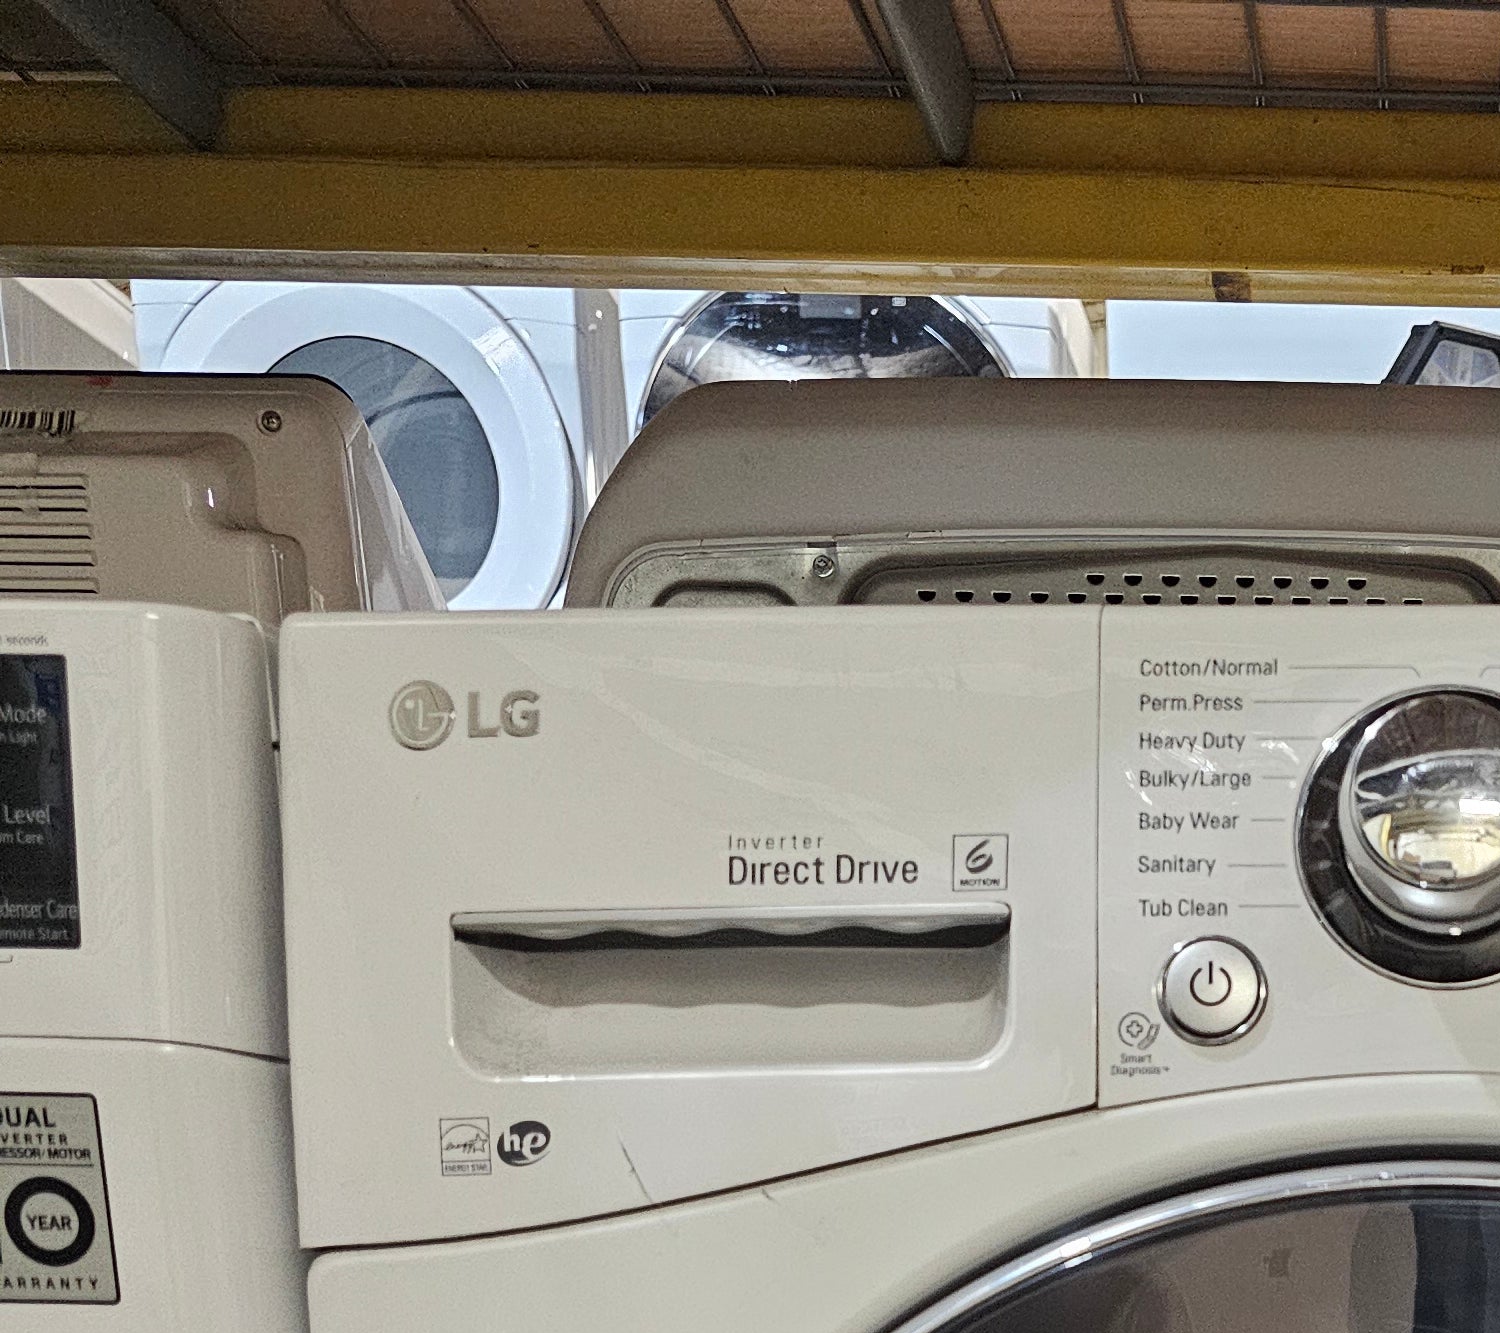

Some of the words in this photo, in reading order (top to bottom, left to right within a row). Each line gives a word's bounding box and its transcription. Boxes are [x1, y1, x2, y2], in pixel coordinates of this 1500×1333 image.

[1139, 658, 1279, 677] Cotton/Normal
[467, 689, 541, 738] LG
[1139, 732, 1197, 752] Heavy
[1202, 731, 1246, 752] Duty
[1139, 769, 1251, 791] Bulky/Large
[3, 804, 51, 825] Level
[1138, 812, 1185, 834] Baby
[1190, 811, 1240, 830] Wear
[727, 834, 825, 850] Inverter
[727, 854, 826, 886] Direct
[835, 853, 920, 885] Drive
[1138, 854, 1217, 877] Sanitary
[1138, 898, 1173, 917] Tub
[1177, 898, 1229, 917] Clean
[0, 1107, 56, 1127] UAL
[26, 1214, 72, 1231] YEAR
